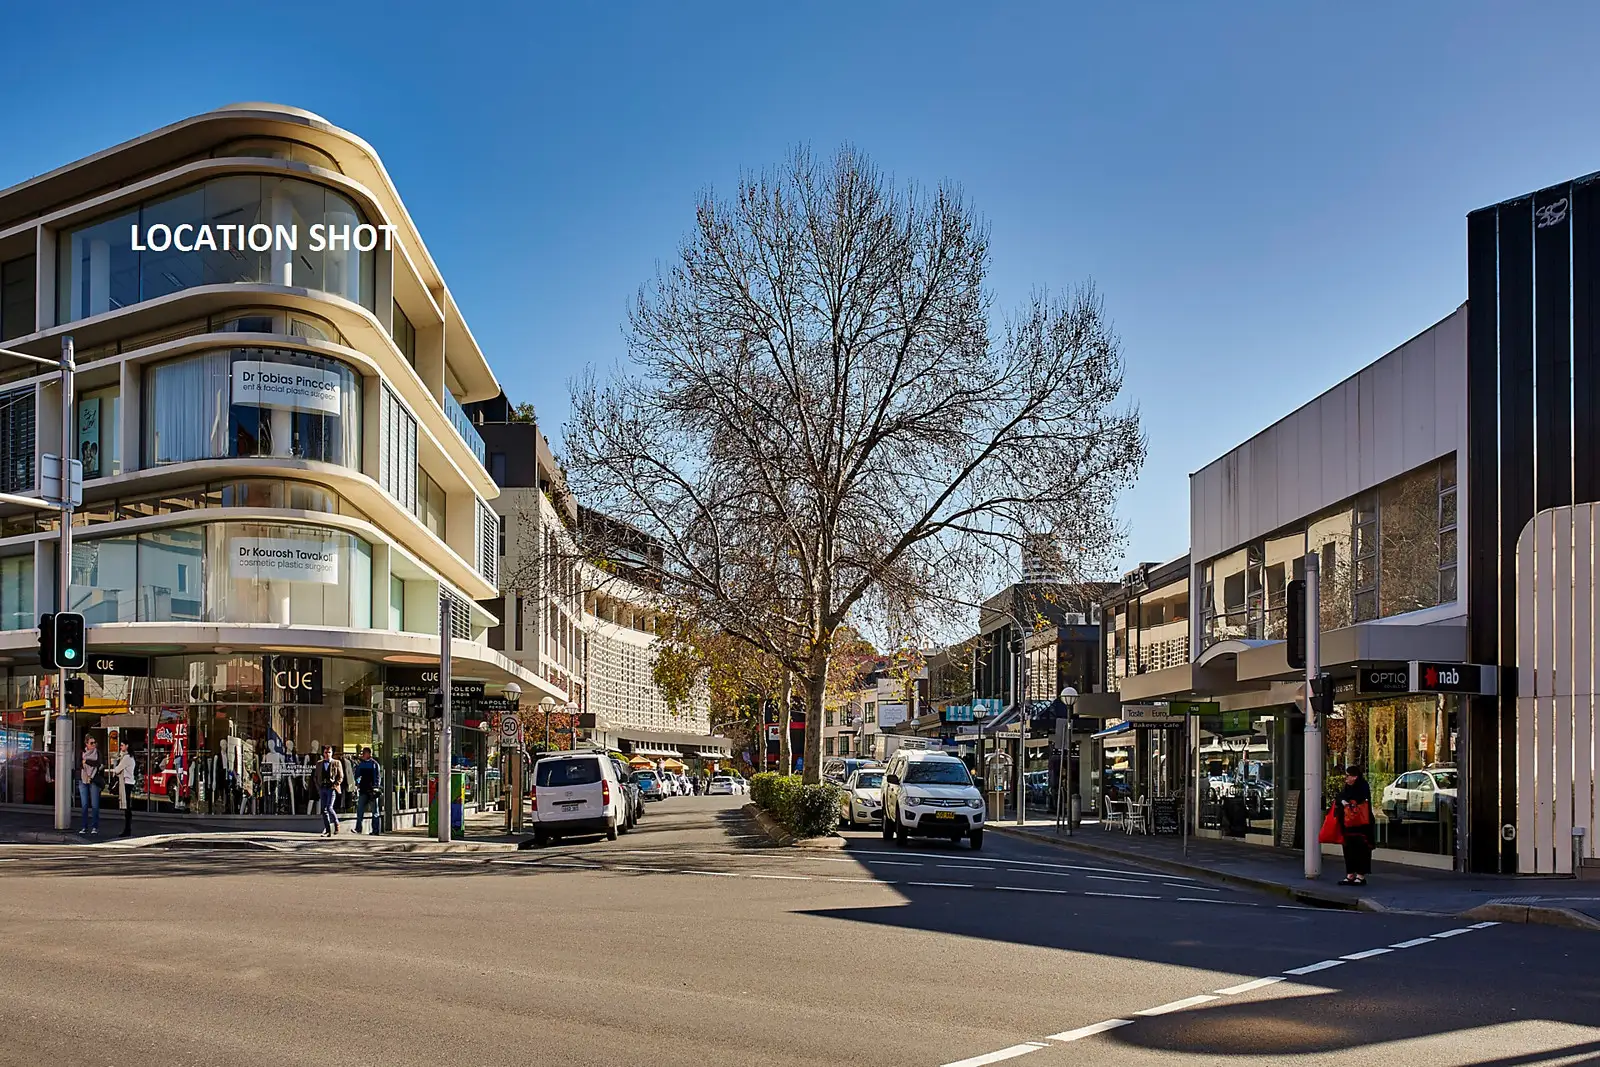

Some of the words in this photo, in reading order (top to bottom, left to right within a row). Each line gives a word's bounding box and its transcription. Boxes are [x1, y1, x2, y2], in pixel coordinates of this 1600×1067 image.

[243, 371, 255, 382] Dr
[258, 372, 293, 386] Tobias
[264, 384, 285, 393] facial
[286, 387, 309, 397] plastic
[310, 391, 336, 400] surgeon
[240, 547, 250, 557] Dr
[253, 547, 293, 559] Kourosh
[296, 549, 333, 562] Tavakoli
[240, 559, 276, 568] cosmetic
[277, 560, 304, 570] plastic
[305, 562, 333, 572] surgeon
[96, 659, 114, 671] CUE
[275, 671, 313, 690] CUE
[421, 672, 439, 682] CUE
[1438, 668, 1460, 684] nab
[1127, 709, 1144, 717] Taste
[504, 721, 516, 732] 50
